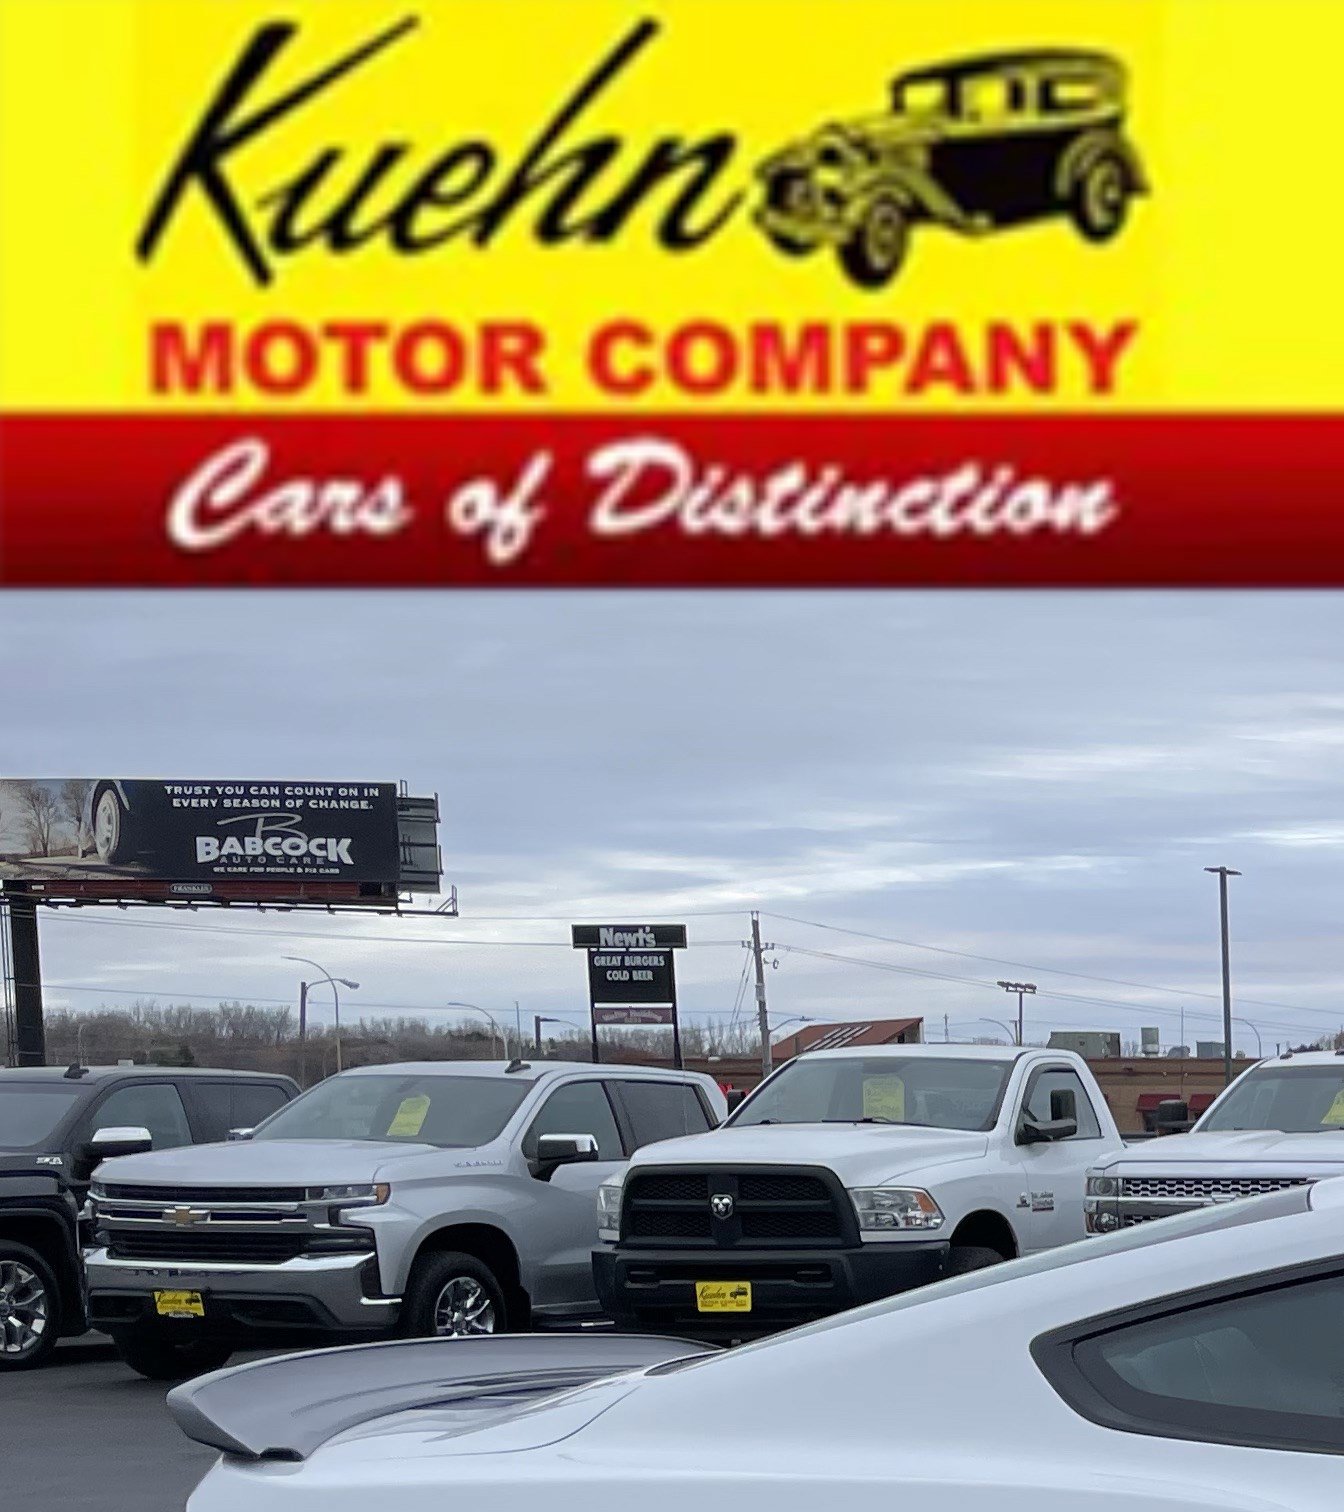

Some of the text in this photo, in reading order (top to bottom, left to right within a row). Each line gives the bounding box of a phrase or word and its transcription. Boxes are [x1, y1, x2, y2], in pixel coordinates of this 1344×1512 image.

[164, 785, 380, 797] TRUST YOU CAN COUNT ON IN
[172, 798, 374, 810] EVERY SEASON OF CHANGE.
[195, 836, 355, 865] BABCOCK
[219, 856, 325, 865] AUTO CARE
[599, 926, 657, 948] Newt's
[594, 956, 665, 967] GREAT BURGERS
[606, 970, 654, 981] COLD BEER
